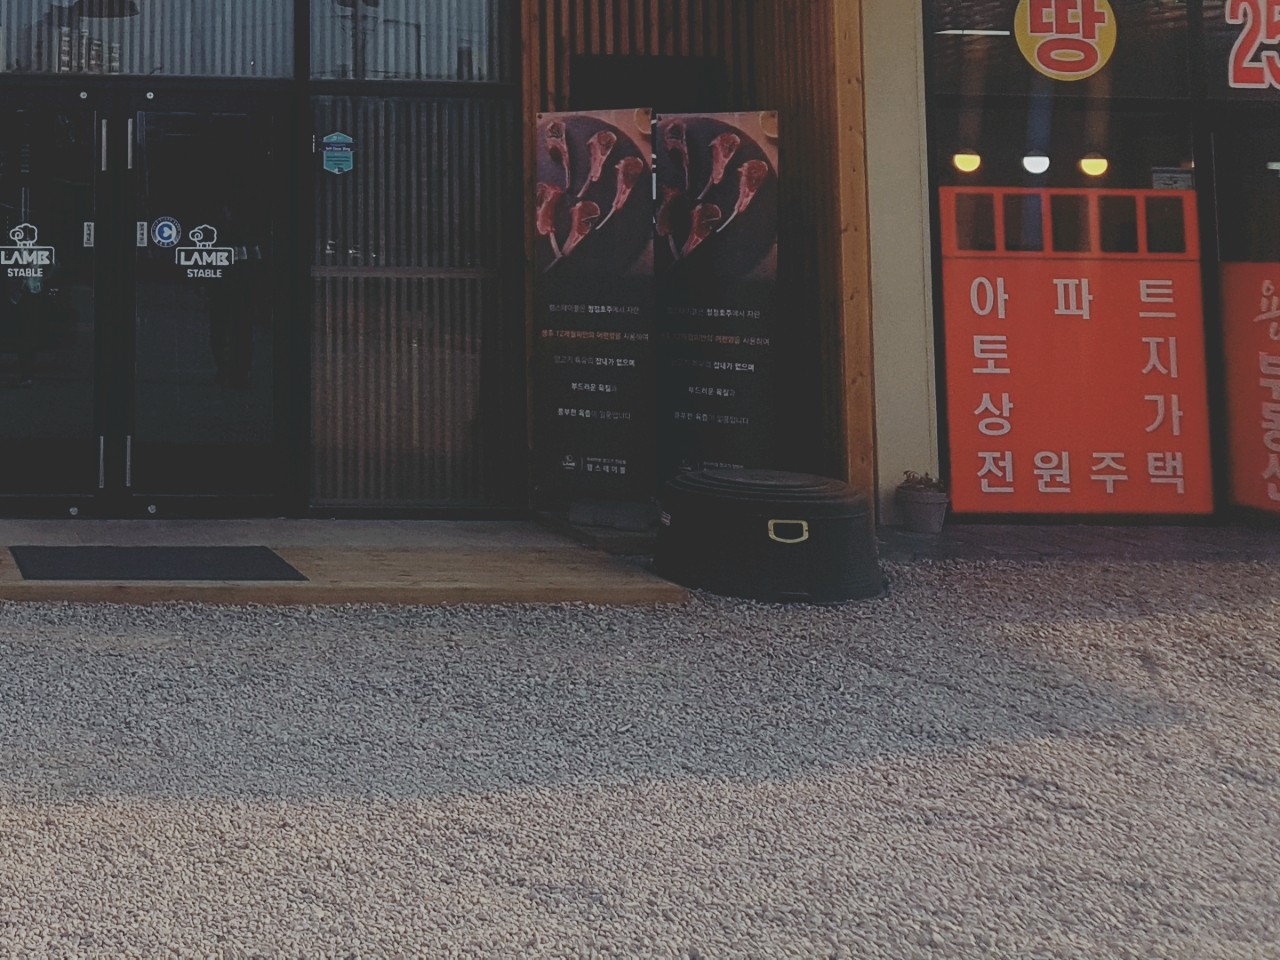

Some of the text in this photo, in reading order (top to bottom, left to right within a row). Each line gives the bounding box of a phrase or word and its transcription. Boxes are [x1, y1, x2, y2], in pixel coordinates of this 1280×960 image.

[0, 250, 50, 265] LAMB
[180, 251, 230, 266] LAMB
[7, 267, 44, 277] STABLE
[186, 268, 222, 278] STABLE
[975, 450, 1186, 495] 전원주택
